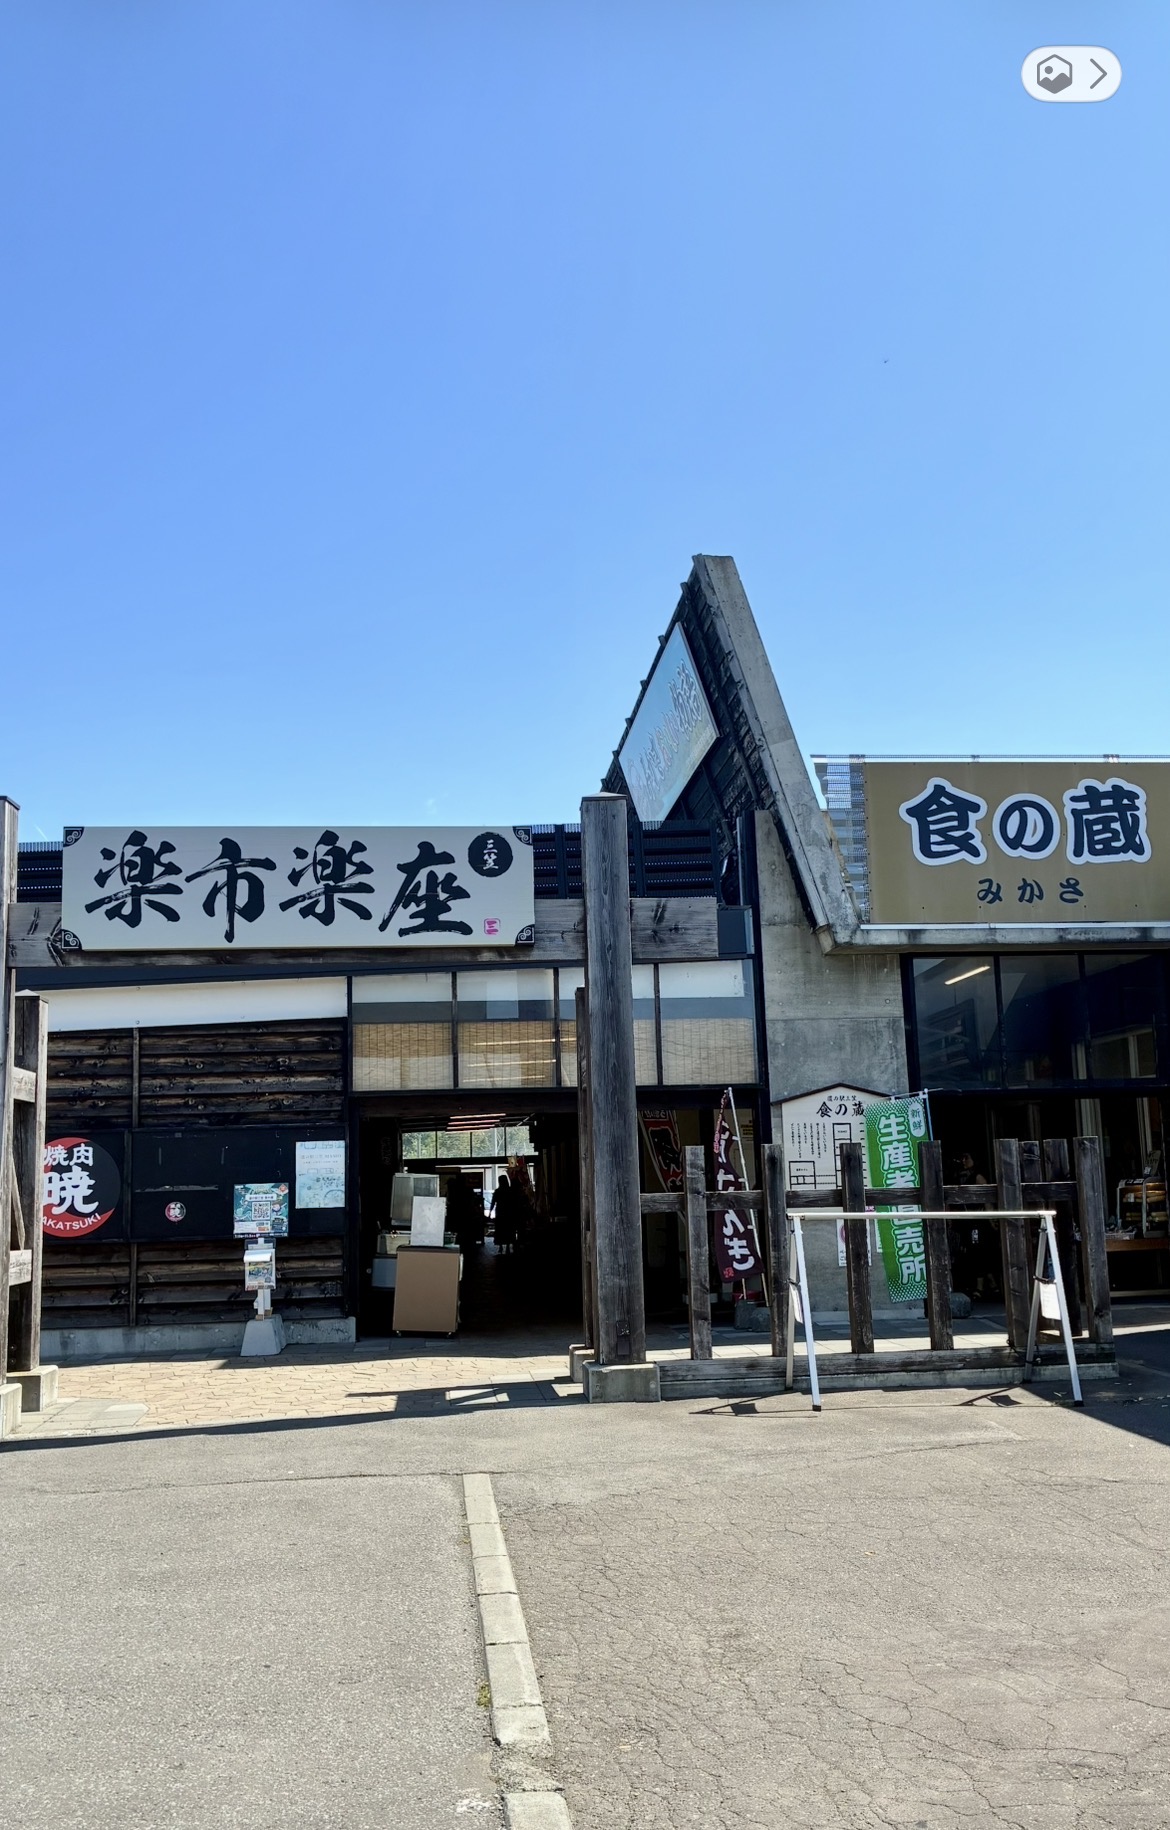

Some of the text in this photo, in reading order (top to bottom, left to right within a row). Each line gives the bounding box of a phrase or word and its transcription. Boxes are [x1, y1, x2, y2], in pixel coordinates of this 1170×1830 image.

[902, 780, 1148, 862] 食の蔵
[482, 838, 500, 871] 三笠
[84, 829, 474, 943] 楽市楽座
[976, 876, 1085, 905] みかさ
[815, 1100, 867, 1118] 食の蔵
[909, 1107, 923, 1131] 新鮮
[44, 1142, 94, 1167] 焼肉
[43, 1165, 99, 1215] 暁
